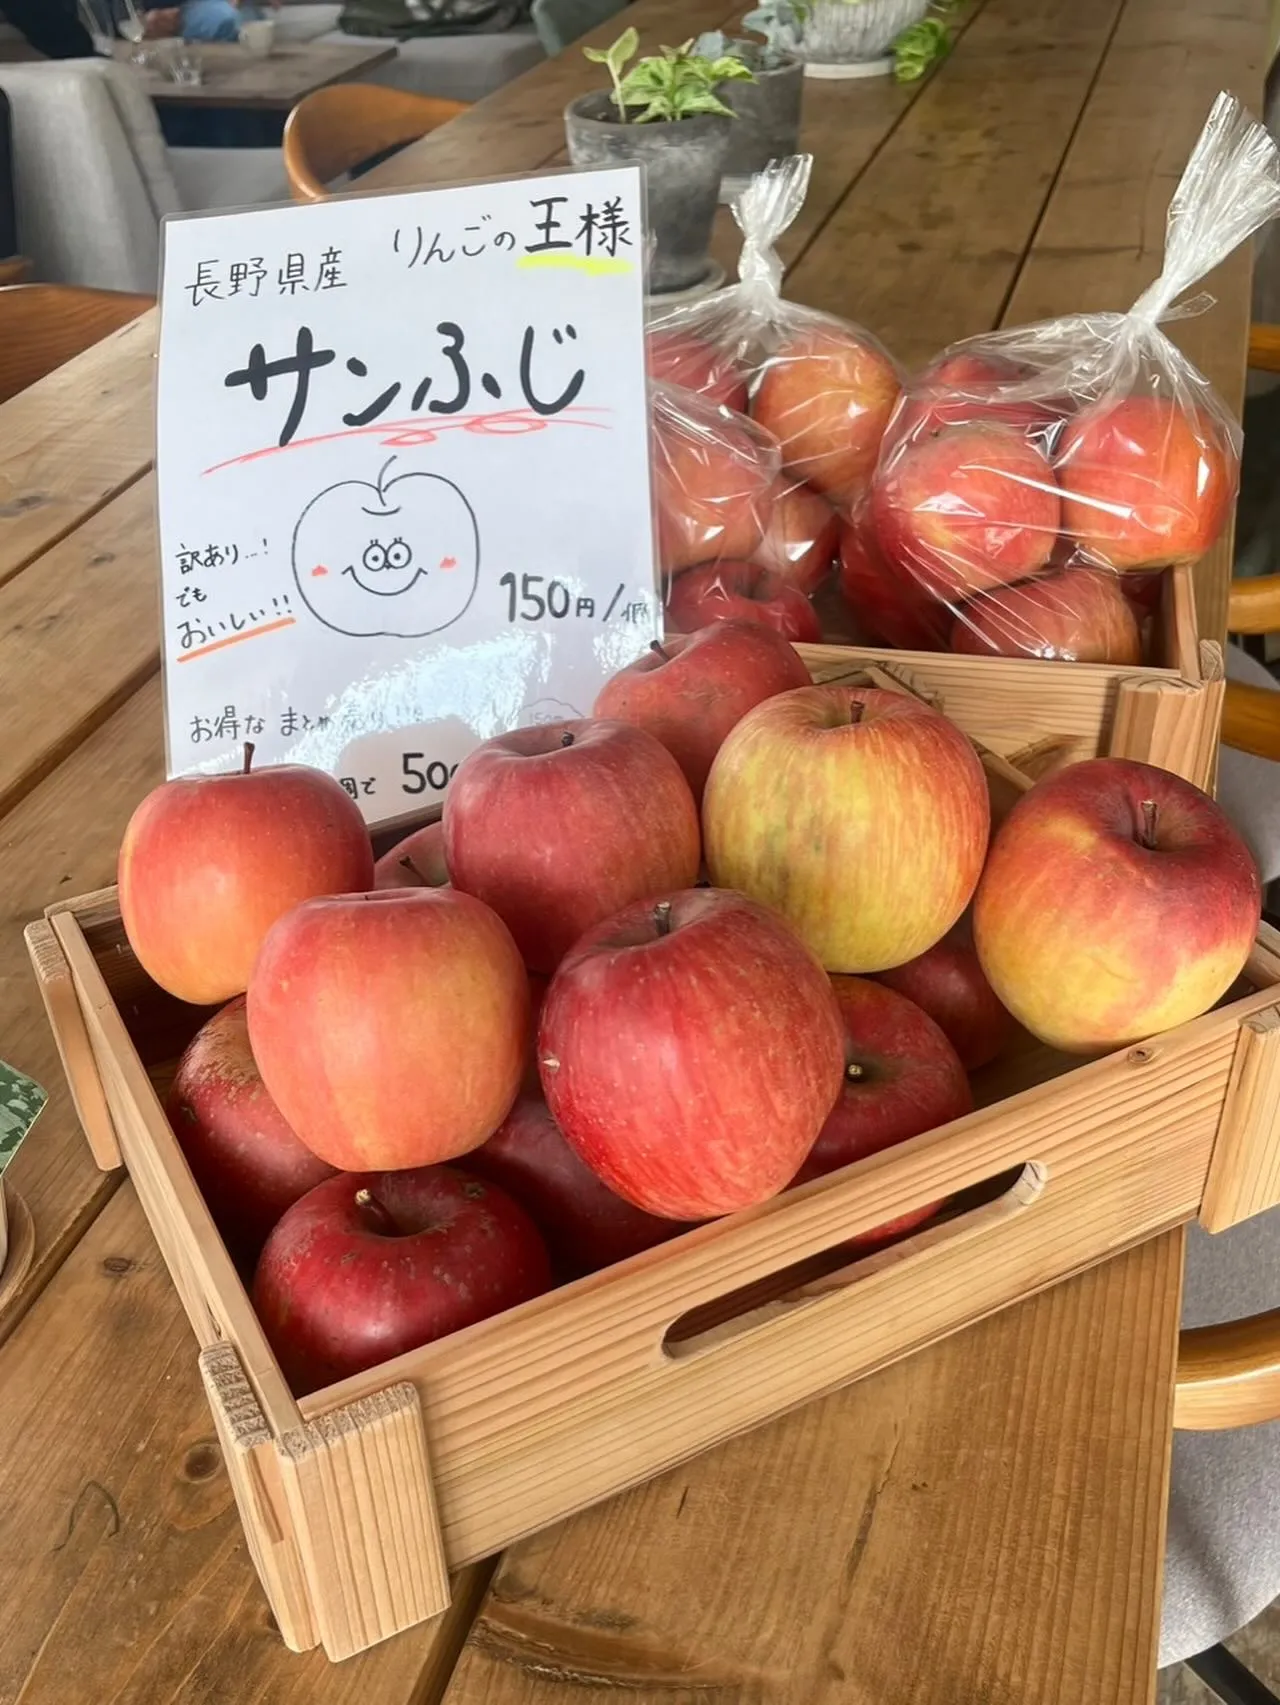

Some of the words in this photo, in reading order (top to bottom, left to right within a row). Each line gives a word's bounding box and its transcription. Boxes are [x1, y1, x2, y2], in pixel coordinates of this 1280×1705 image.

[393, 196, 634, 269] りんごの王様
[184, 246, 348, 307] 長野県産
[224, 321, 585, 447] サンふじ
[175, 585, 208, 608] でも
[401, 752, 460, 795] 50
